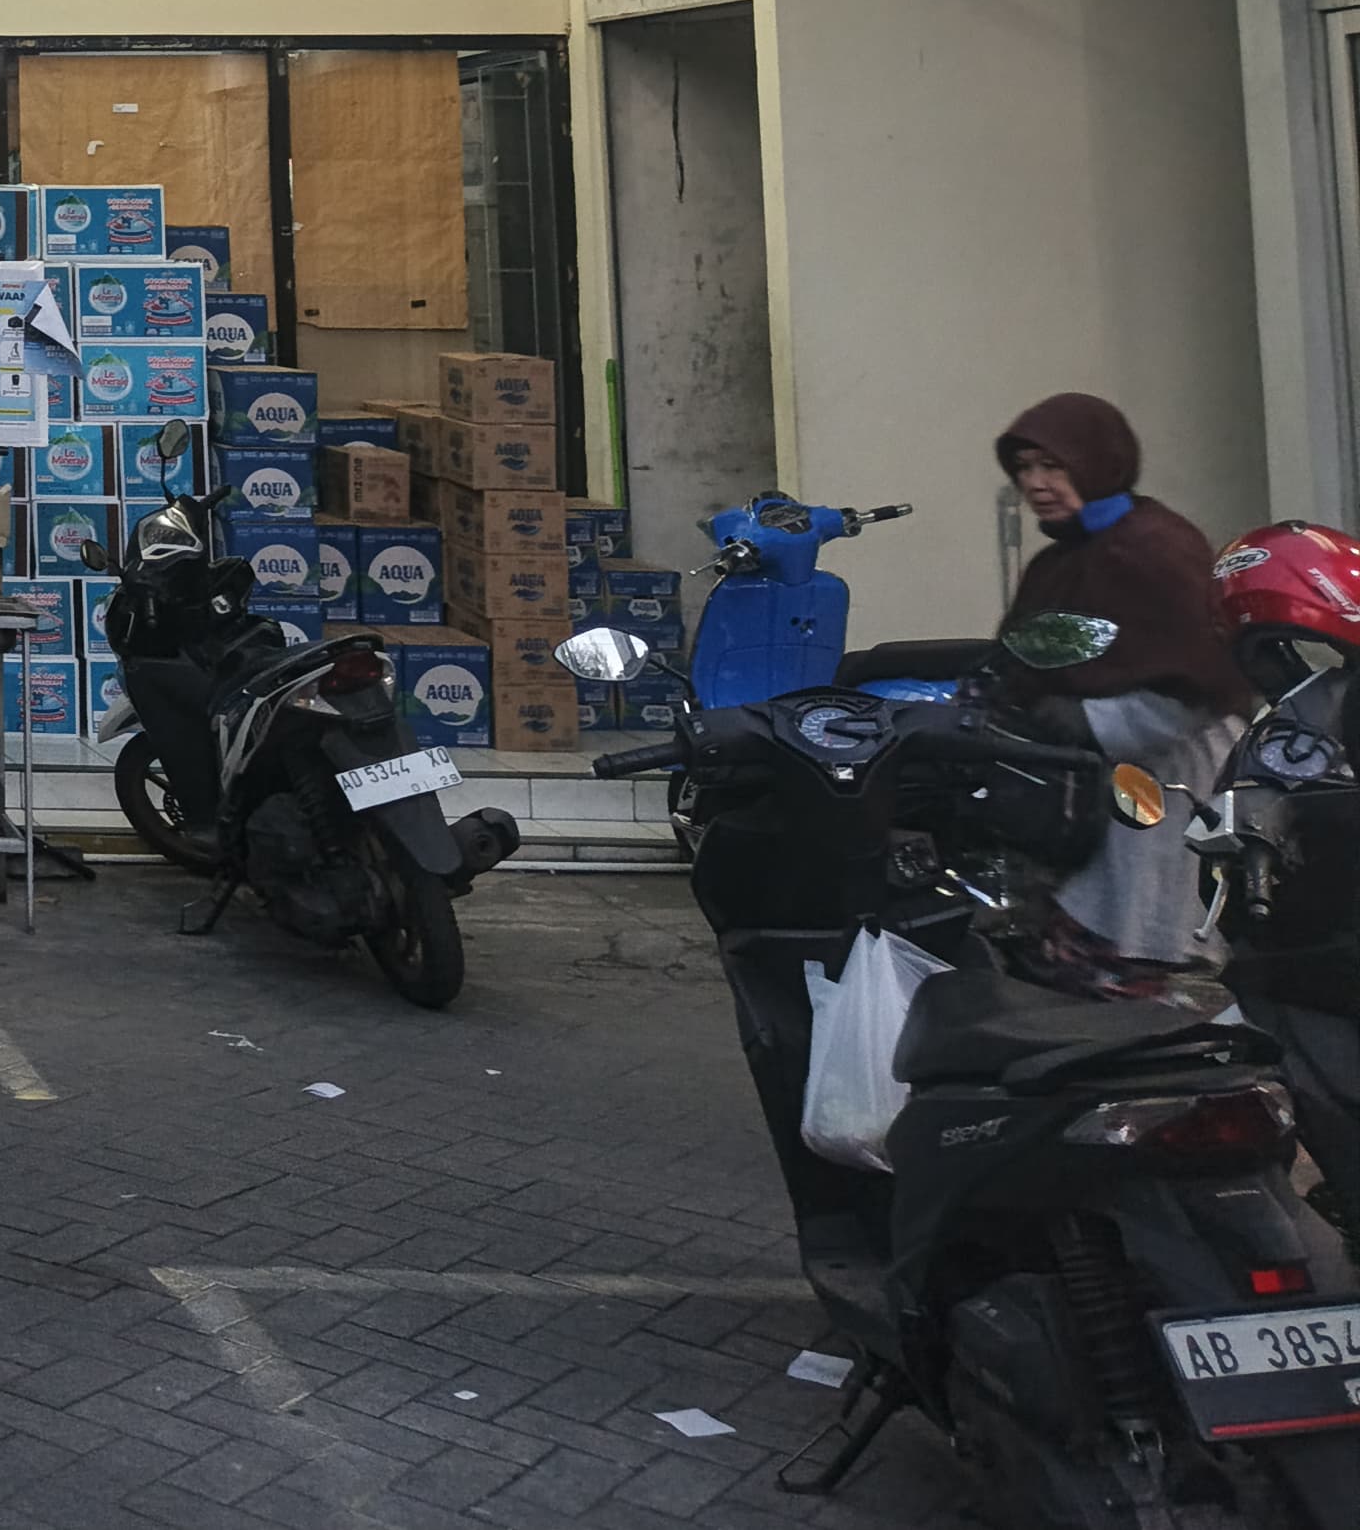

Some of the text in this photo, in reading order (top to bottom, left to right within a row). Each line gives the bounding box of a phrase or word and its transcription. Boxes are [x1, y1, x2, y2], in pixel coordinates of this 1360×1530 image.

[207, 327, 248, 342] AQUA
[495, 378, 531, 391] AQUA
[255, 406, 299, 425] AQUA
[249, 482, 294, 498] AQUA
[257, 559, 301, 574] AQUA
[380, 563, 425, 583] AQUA
[509, 574, 546, 587] AQUA
[426, 684, 473, 703] AQUA
[364, 758, 411, 783] 5344
[1186, 1331, 1240, 1378] AB
